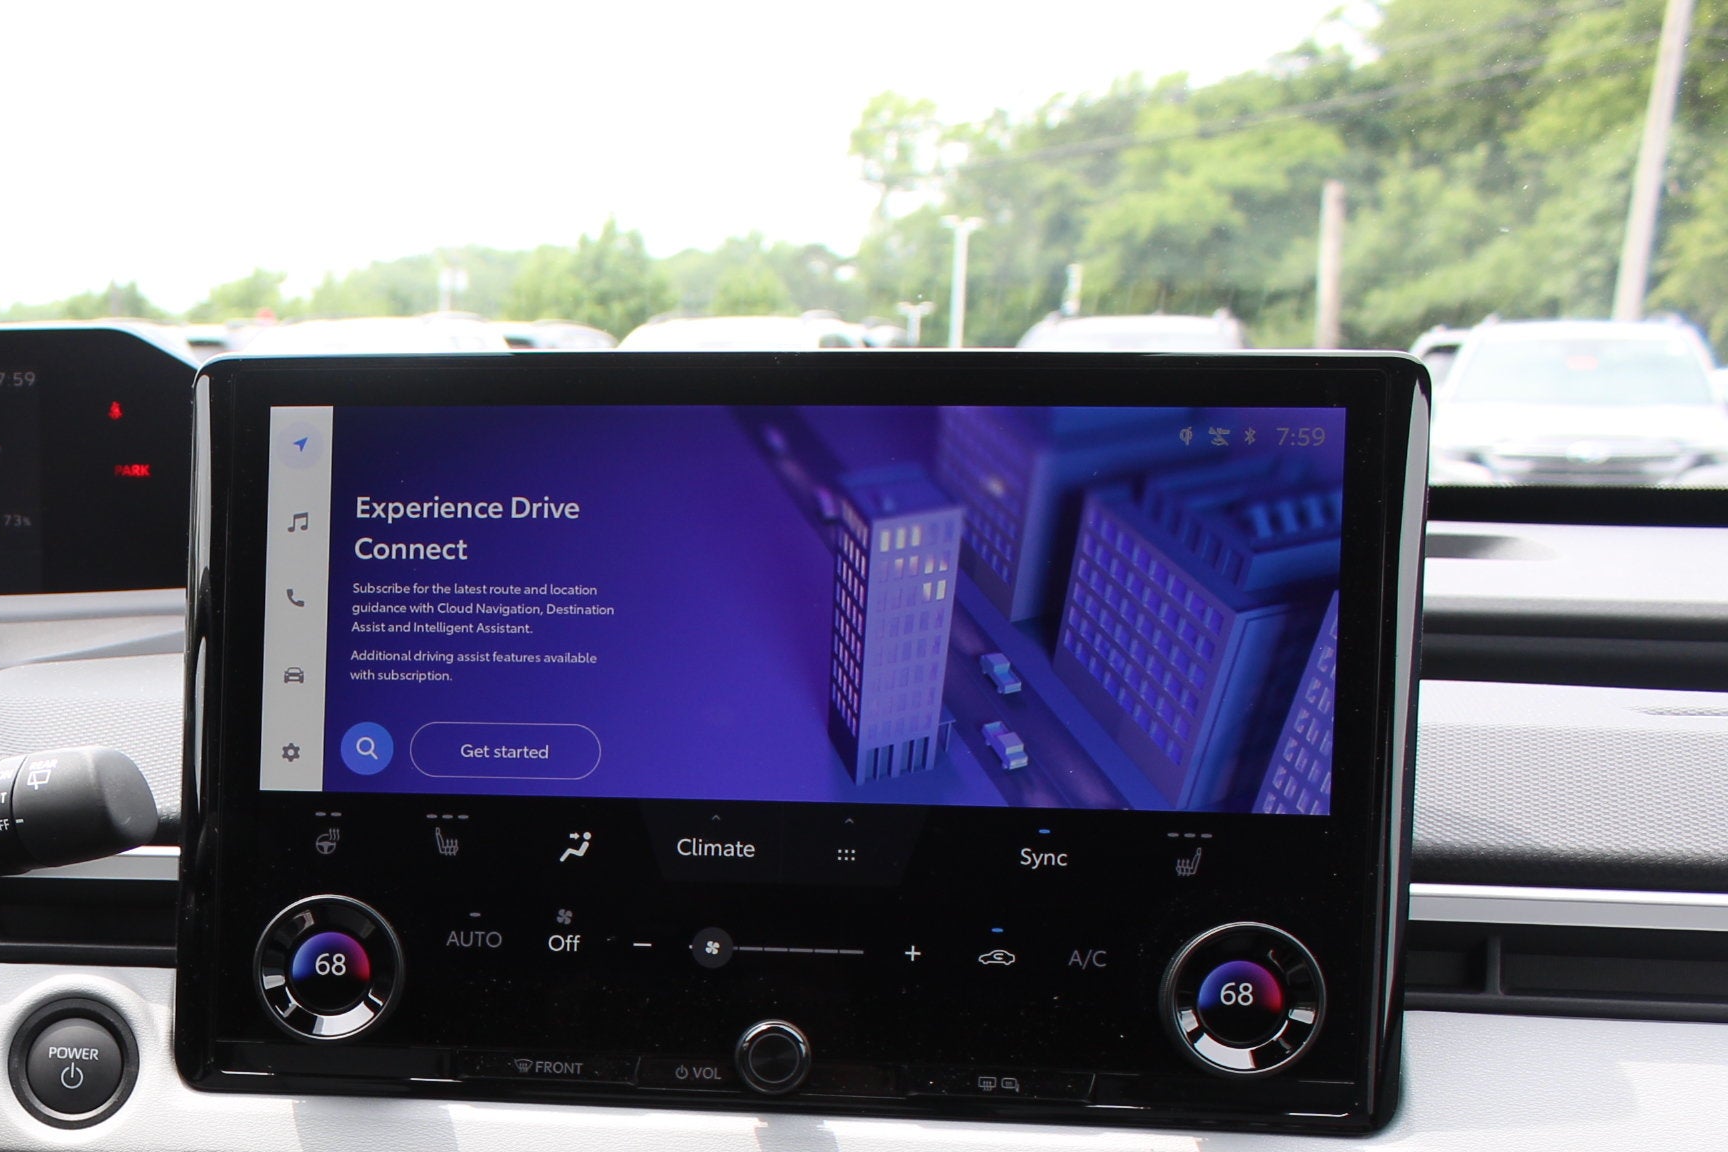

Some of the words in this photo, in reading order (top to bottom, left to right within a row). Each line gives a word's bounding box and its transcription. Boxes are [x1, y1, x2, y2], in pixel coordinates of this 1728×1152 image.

[1277, 426, 1328, 448] 7:59
[115, 464, 150, 476] PARK
[357, 496, 503, 524] Experience
[511, 496, 579, 519] Drive
[355, 538, 467, 560] Connect
[353, 583, 410, 593] Subscribe
[413, 583, 429, 593] for
[432, 583, 451, 594] the
[455, 583, 486, 594] latest
[490, 585, 521, 594] route
[524, 584, 547, 594] and
[551, 584, 597, 595] location
[352, 602, 406, 615] guidance
[410, 602, 434, 613] with
[438, 603, 473, 613] Cloud
[476, 604, 543, 616] Navigation,
[547, 604, 614, 615] Destination
[352, 622, 385, 632] Assist
[388, 621, 410, 632] and
[414, 622, 473, 635] Intelligent
[476, 623, 533, 633] Assistant.
[351, 650, 411, 661] Additional
[414, 650, 453, 664] driving
[457, 652, 490, 662] assist
[493, 652, 540, 662] features
[544, 652, 597, 663] available
[350, 670, 374, 680] with
[378, 669, 452, 683] subscription.
[461, 744, 489, 757] Get
[494, 745, 548, 759] started
[27, 758, 58, 771] REAR
[677, 838, 755, 857] Climate
[1021, 848, 1067, 869] Sync
[446, 931, 502, 948] AUTO
[549, 935, 580, 951] Off
[313, 952, 346, 975] 68
[1069, 950, 1106, 969] A/C
[1219, 981, 1253, 1005] 68
[49, 1047, 98, 1060] POWER
[536, 1061, 582, 1074] FRONT
[693, 1067, 721, 1079] VOL
